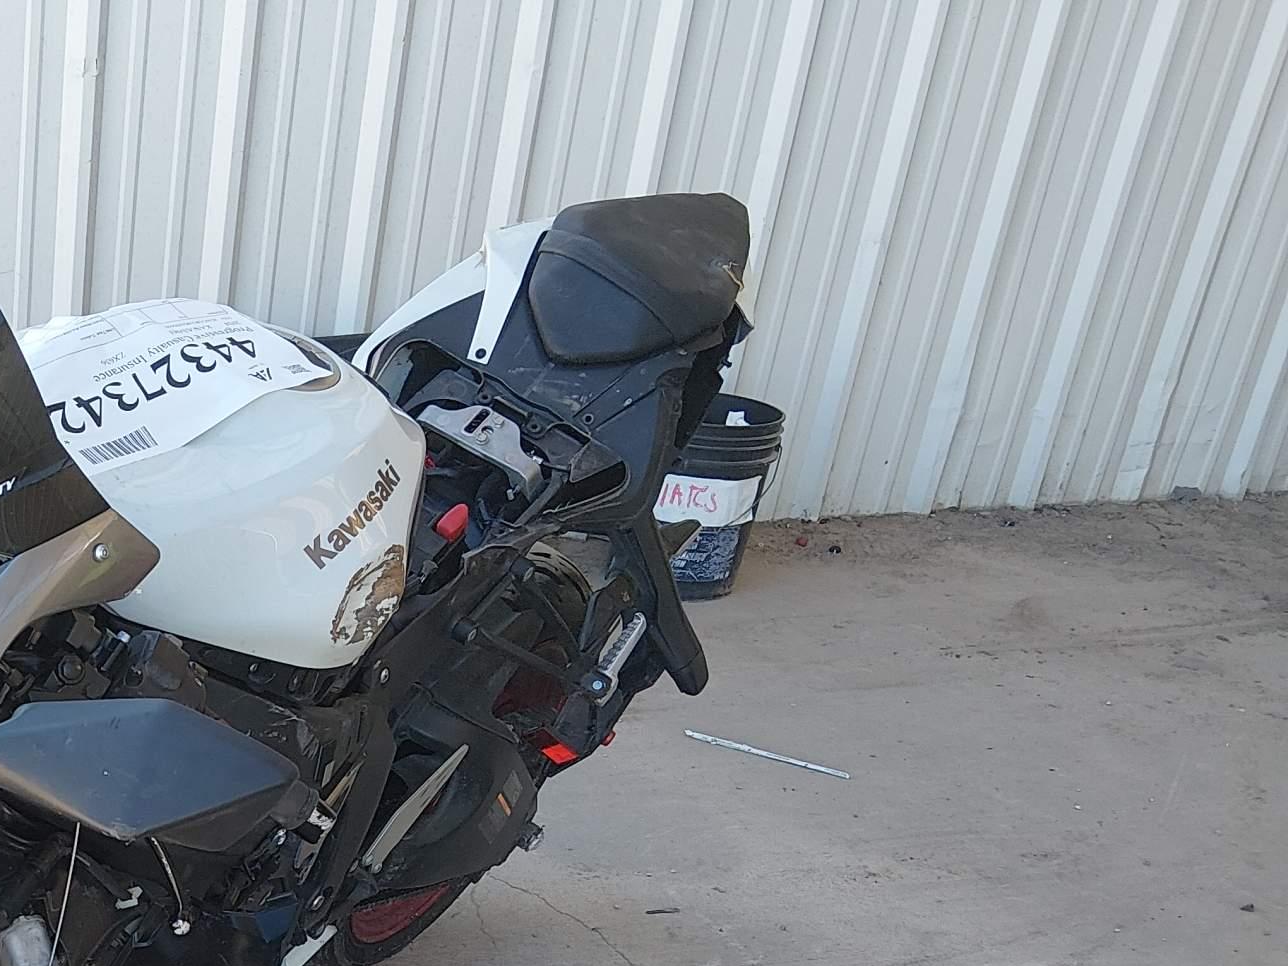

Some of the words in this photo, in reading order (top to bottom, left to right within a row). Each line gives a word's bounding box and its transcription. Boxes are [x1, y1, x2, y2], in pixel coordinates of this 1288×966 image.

[92, 354, 148, 383] Insurance
[147, 334, 195, 358] Casualty
[46, 336, 257, 434] 44327342
[302, 458, 402, 571] Kawasaki
